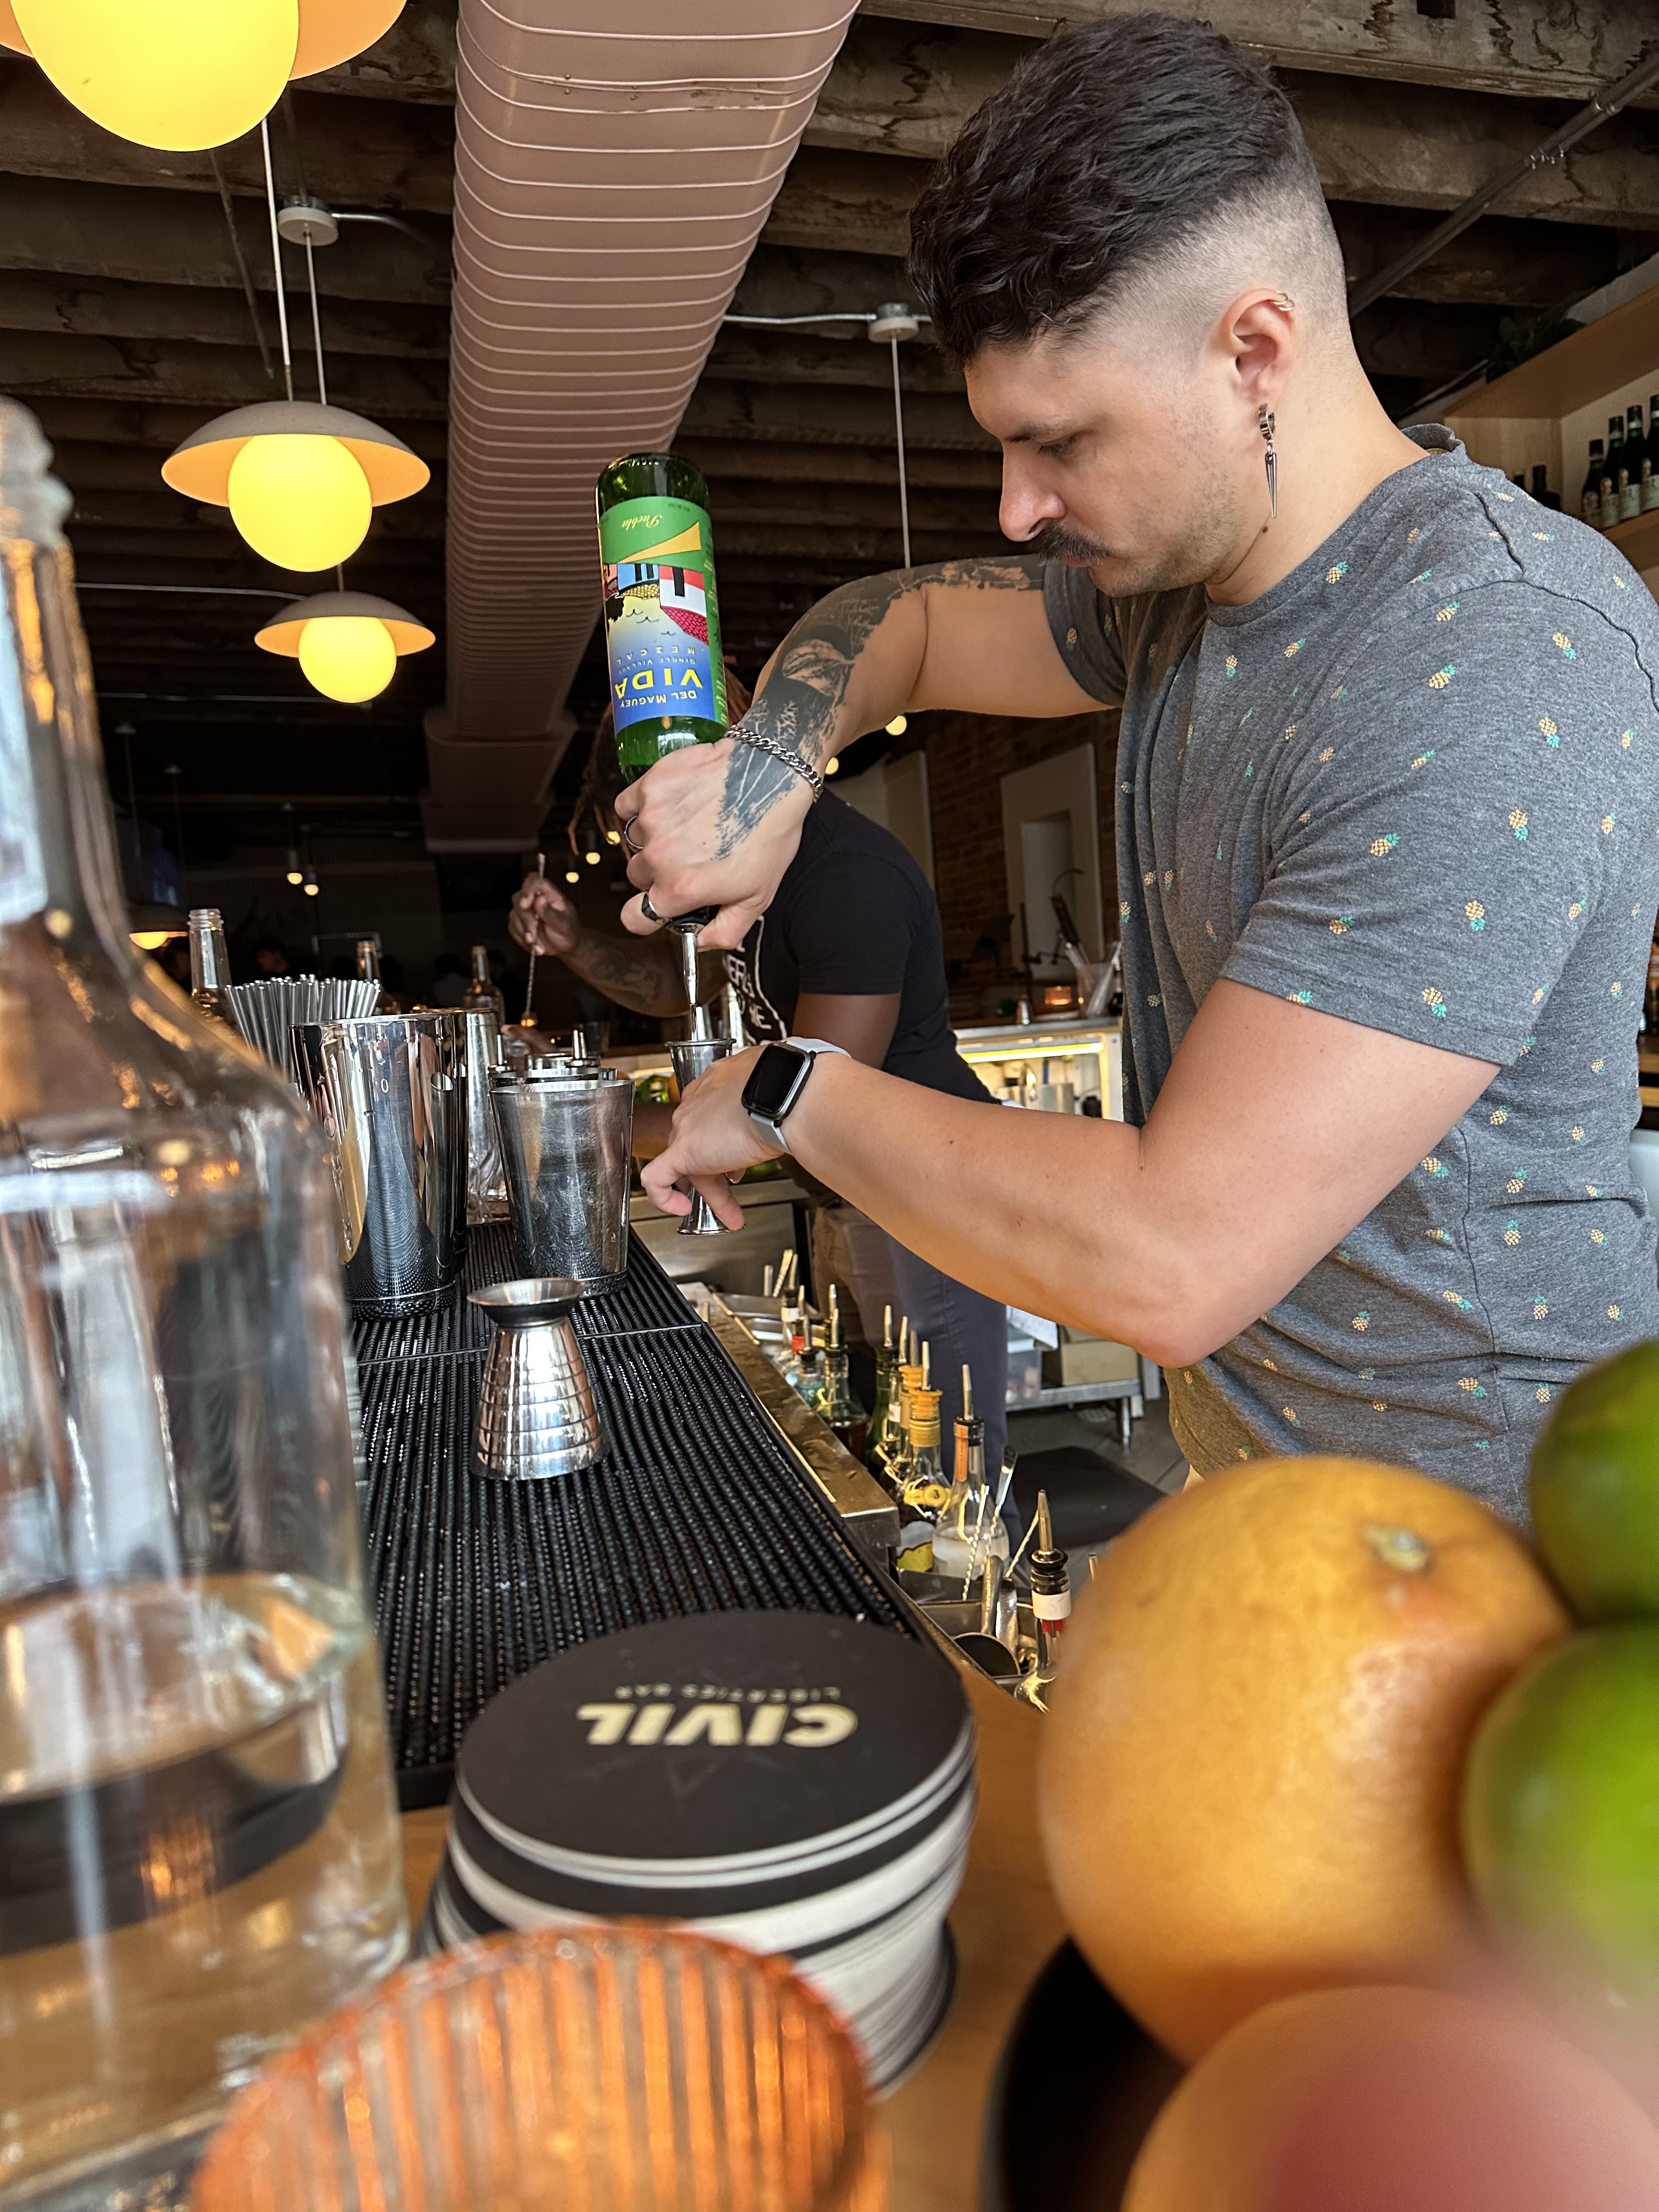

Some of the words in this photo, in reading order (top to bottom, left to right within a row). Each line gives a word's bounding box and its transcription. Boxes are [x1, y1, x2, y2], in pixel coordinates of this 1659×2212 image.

[622, 515, 662, 531] Puebla
[617, 646, 695, 665] MEZCAL
[618, 659, 653, 674] VILLAGE
[614, 668, 703, 699] VIDA
[620, 694, 667, 708] MAGUEY
[672, 690, 697, 699] DEL
[933, 1489, 940, 1499] 3
[614, 1683, 672, 1700] BAR
[680, 1684, 842, 1703] LIBERTIES
[575, 1703, 858, 1747] CIVIL
